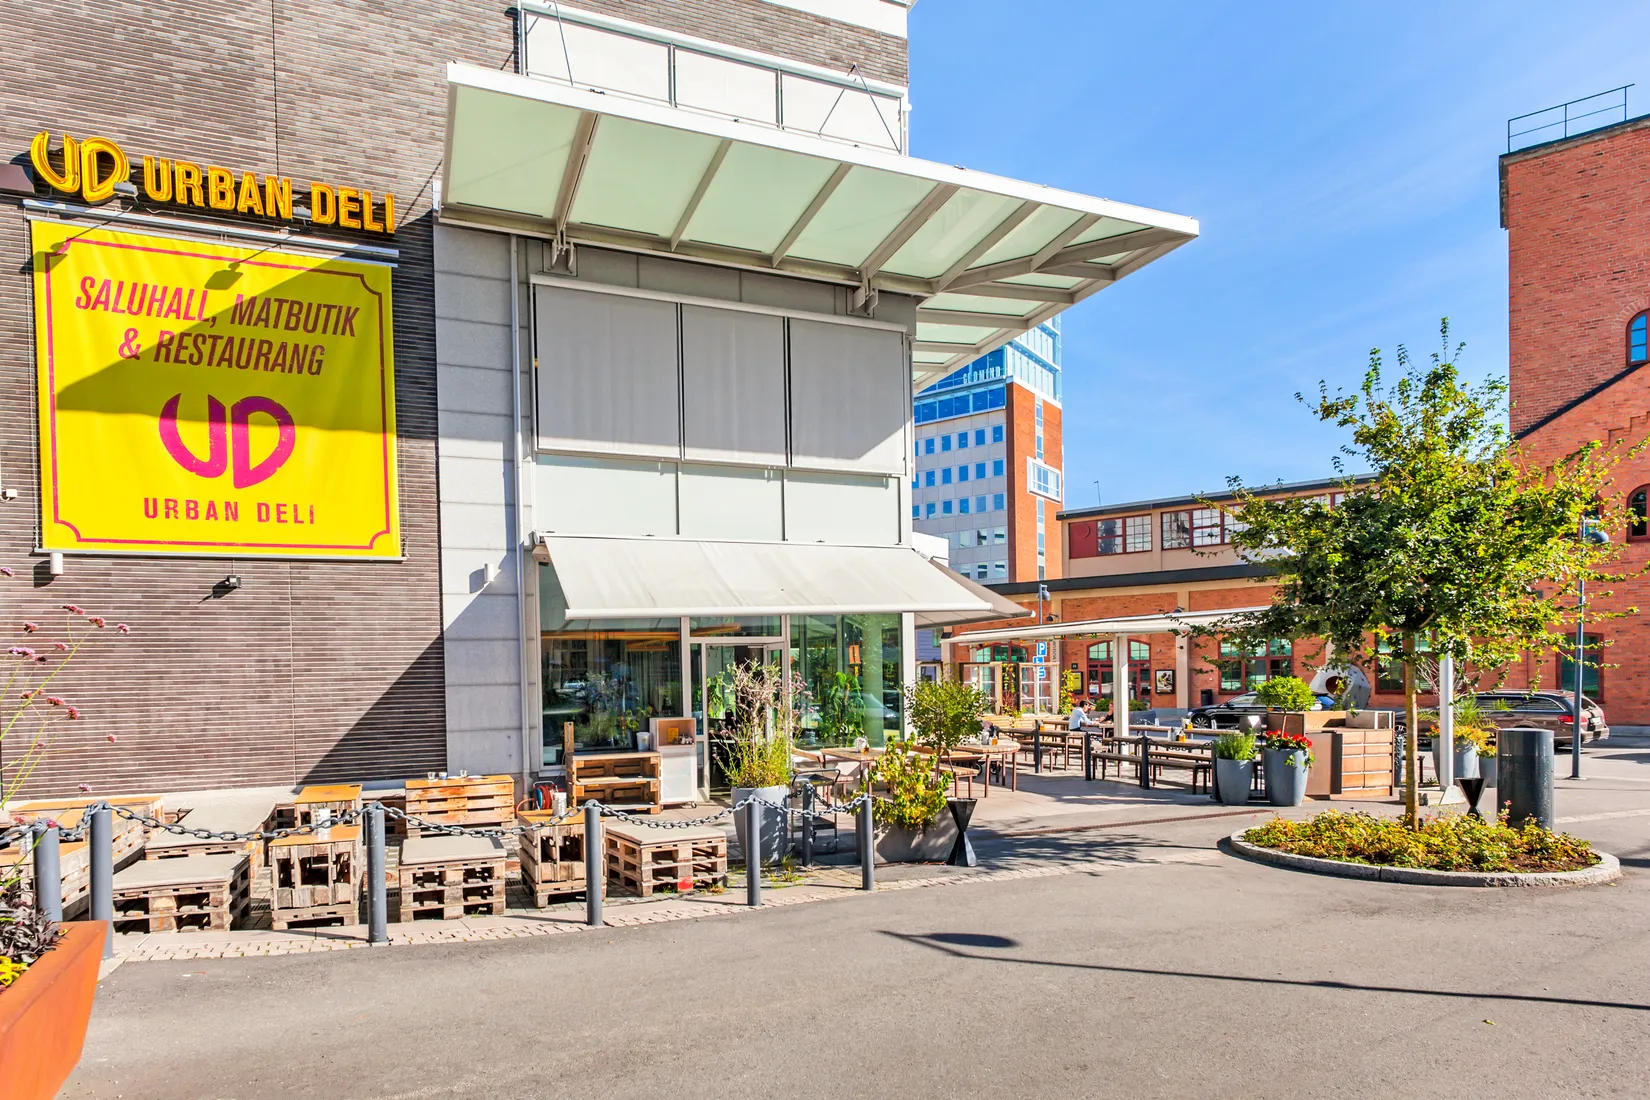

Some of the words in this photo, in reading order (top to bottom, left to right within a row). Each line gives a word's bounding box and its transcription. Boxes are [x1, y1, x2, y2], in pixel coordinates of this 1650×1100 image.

[27, 131, 130, 202] UD
[143, 155, 293, 219] URBAN
[311, 182, 396, 234] DELI
[75, 276, 217, 327] SALUHALL,
[230, 294, 360, 337] MATBUTIK
[118, 328, 141, 360] &
[154, 330, 325, 376] RESTAURANG
[159, 393, 296, 489] UD
[143, 497, 239, 522] URBAN
[257, 502, 315, 525] DELI
